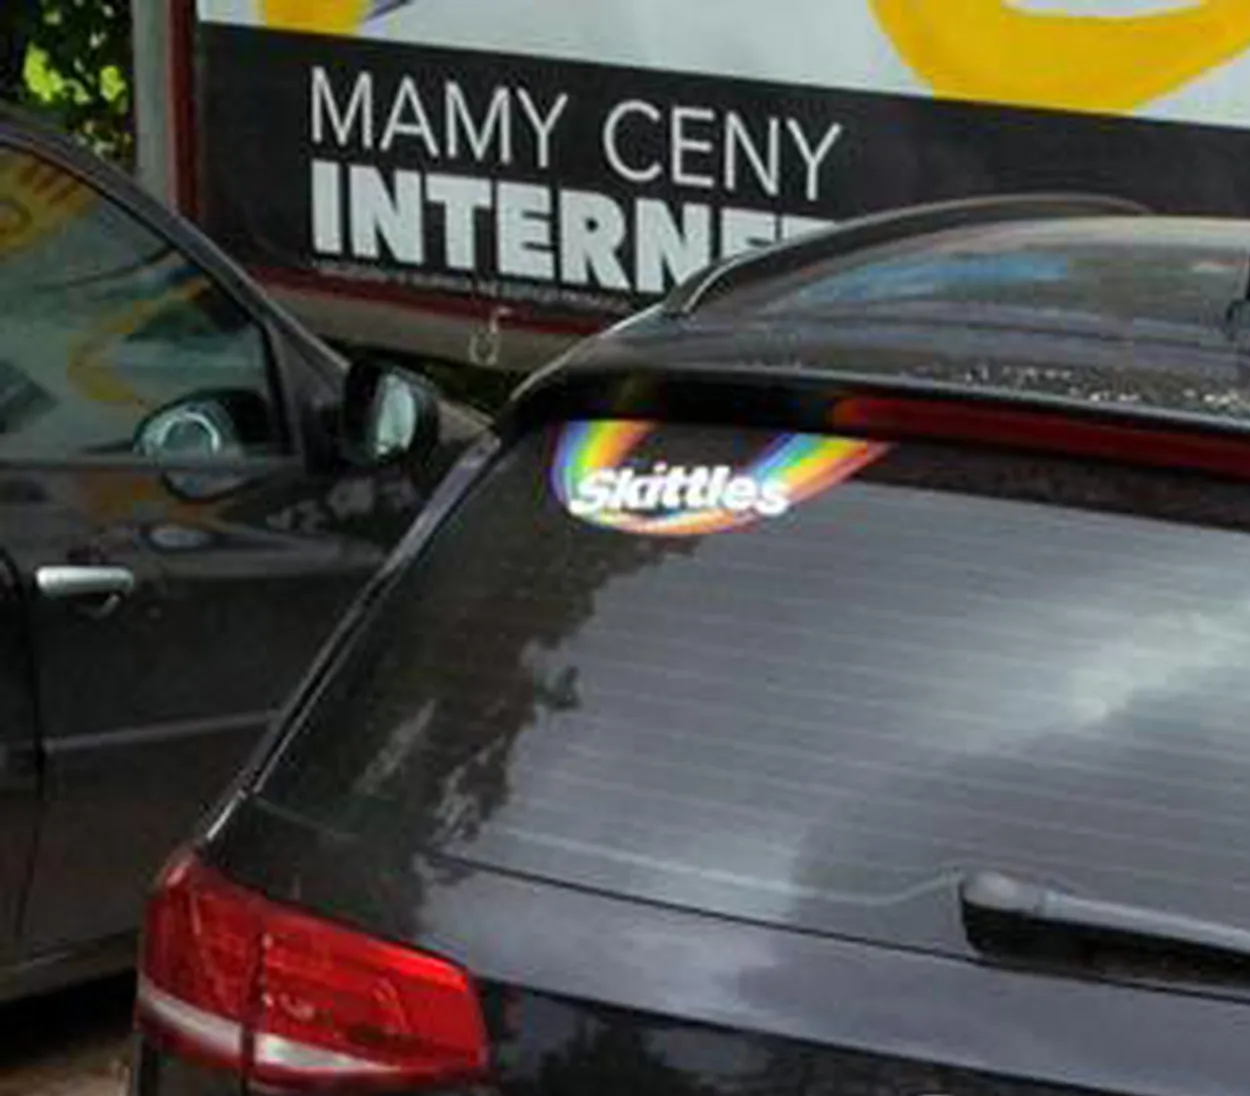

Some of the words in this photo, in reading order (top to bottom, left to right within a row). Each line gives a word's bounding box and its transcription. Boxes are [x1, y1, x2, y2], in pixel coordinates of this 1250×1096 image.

[311, 66, 567, 168] MAMY
[603, 100, 841, 200] CENY
[568, 461, 790, 516] Skittles
